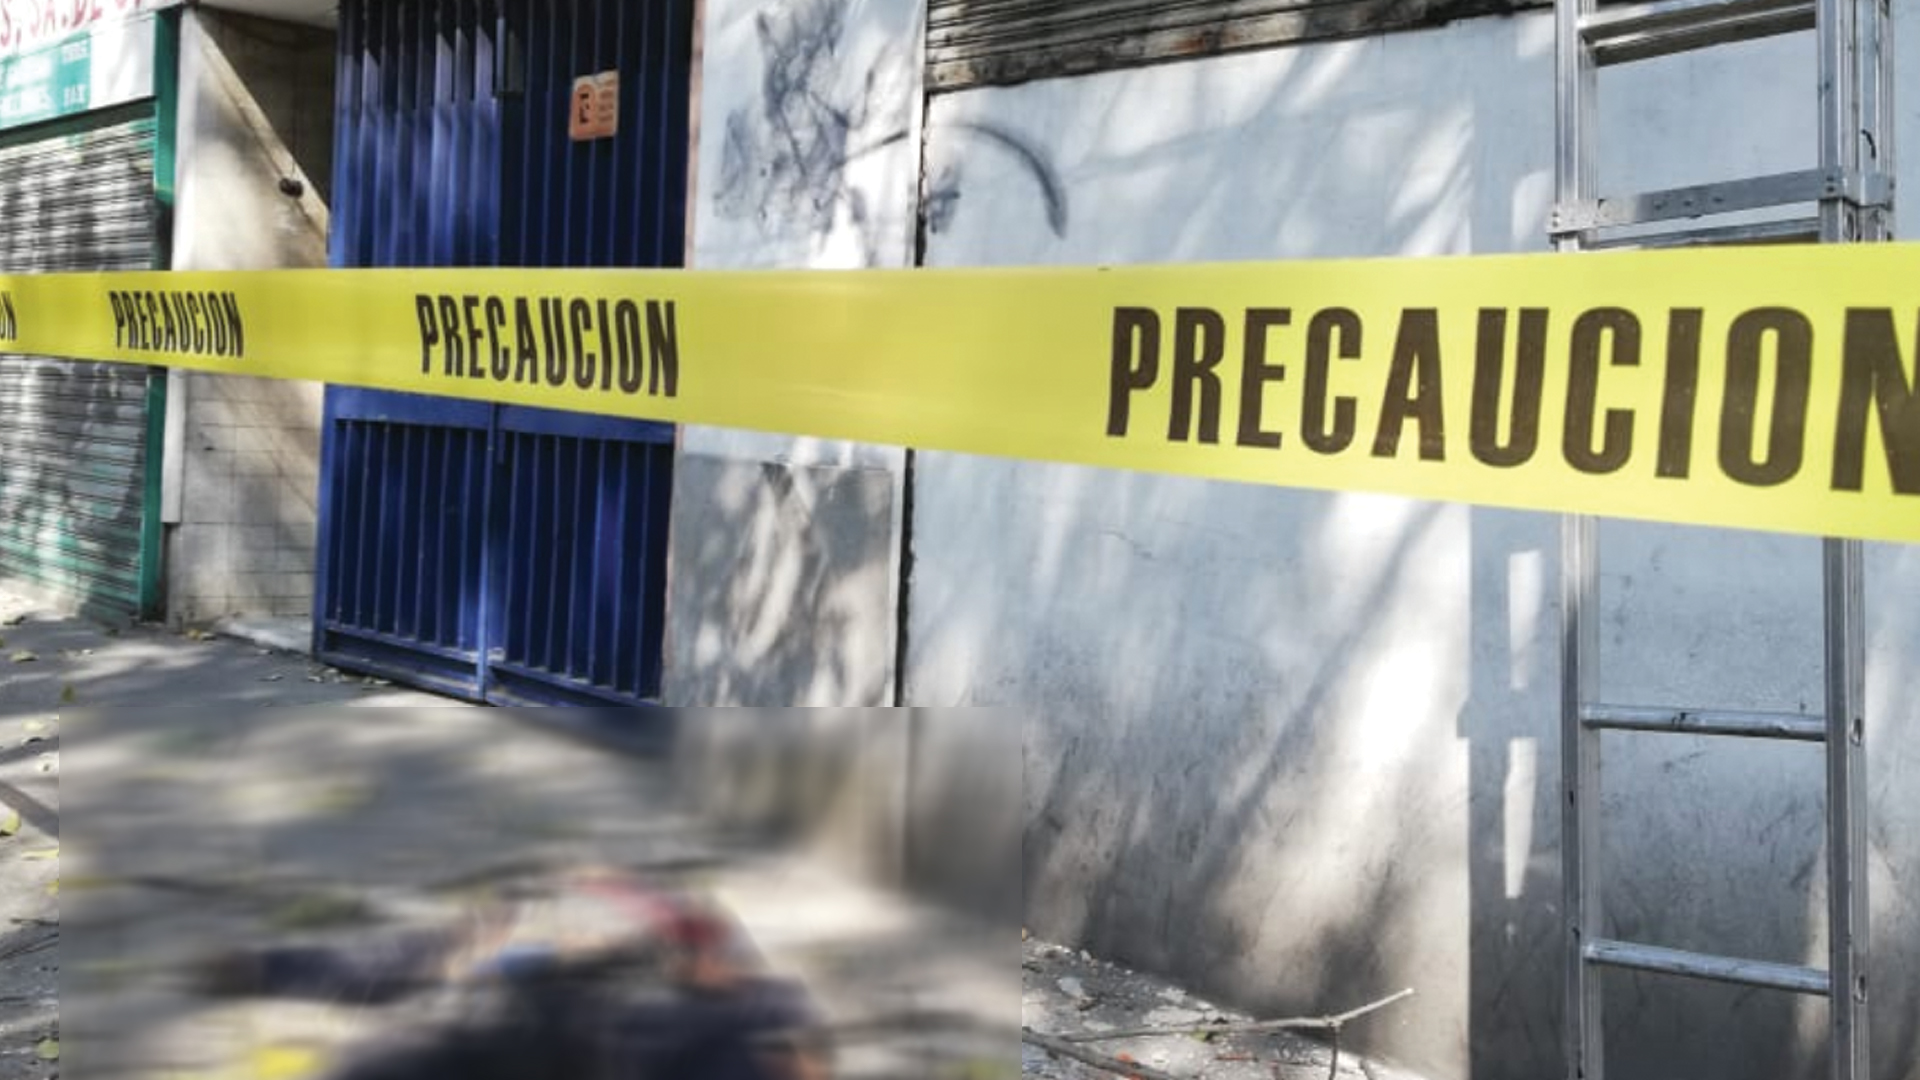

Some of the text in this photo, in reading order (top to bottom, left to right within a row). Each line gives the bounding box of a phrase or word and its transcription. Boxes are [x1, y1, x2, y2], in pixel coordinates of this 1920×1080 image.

[108, 290, 244, 358] PRECAUCION
[415, 294, 678, 397] PRECAUCION
[1105, 306, 1920, 495] PRECAUCION
